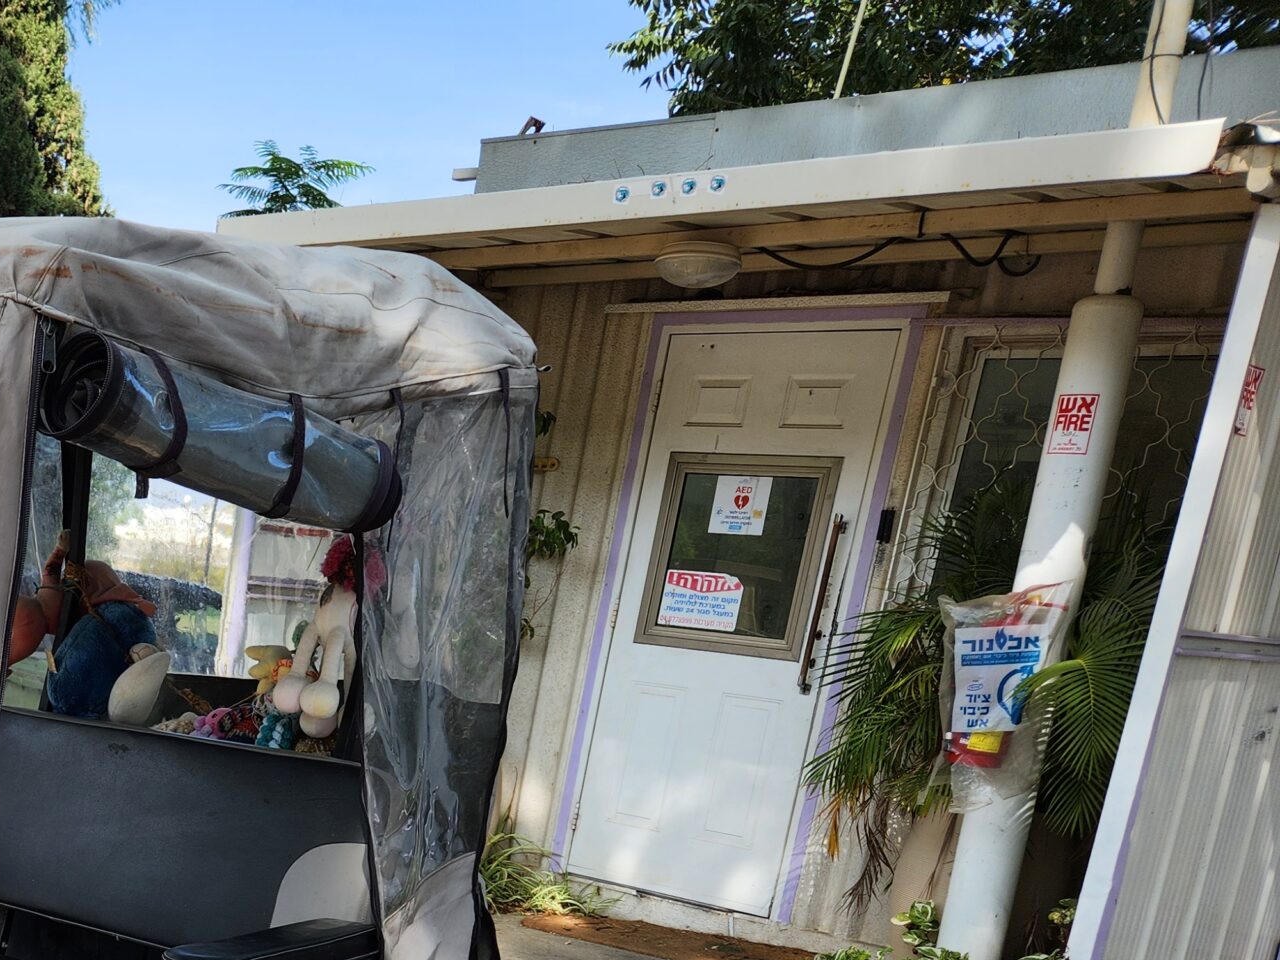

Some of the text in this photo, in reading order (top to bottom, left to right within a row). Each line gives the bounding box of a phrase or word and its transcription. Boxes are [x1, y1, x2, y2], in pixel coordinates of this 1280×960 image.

[1058, 397, 1096, 413] אש
[1054, 413, 1092, 432] FIRE
[735, 486, 753, 494] AED
[672, 572, 736, 592] אזהרה!
[721, 597, 739, 605] מקום
[965, 693, 991, 703] ציוד
[959, 706, 990, 715] כיבוי
[966, 719, 989, 729] אש
